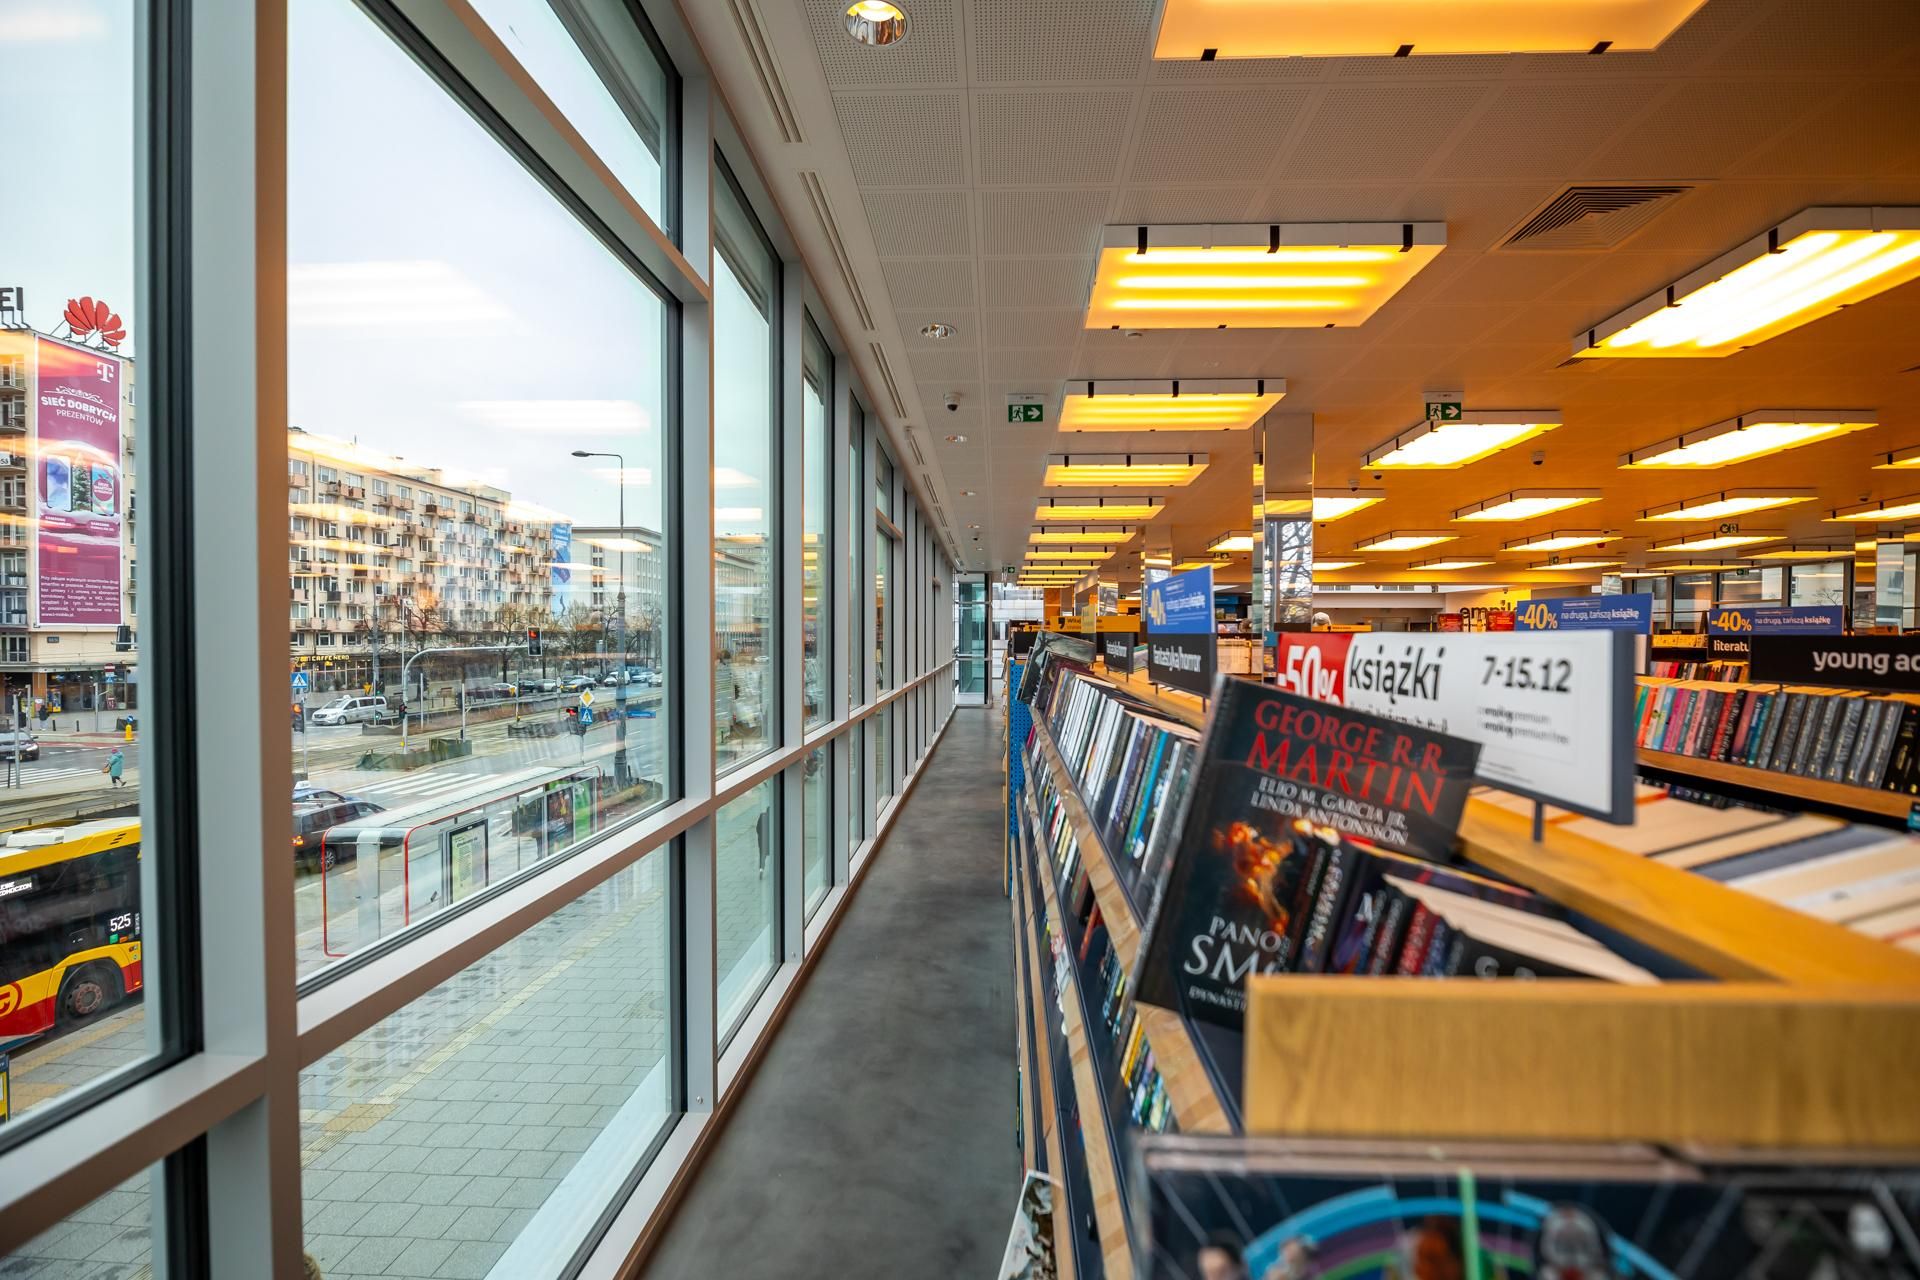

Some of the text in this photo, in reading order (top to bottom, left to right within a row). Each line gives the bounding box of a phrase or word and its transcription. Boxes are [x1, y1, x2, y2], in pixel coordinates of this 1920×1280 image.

[0, 286, 24, 311] EI
[96, 361, 115, 383] T
[41, 395, 117, 422] SIEĆ DOBRYCH
[56, 408, 104, 426] PREZENTÓW
[1518, 603, 1558, 630] -40%
[1711, 611, 1752, 631] -40%
[1782, 616, 1804, 626] tańszą
[1804, 615, 1832, 625] książkę
[1349, 644, 1447, 704] książki
[1812, 651, 1891, 675] young
[1254, 699, 1384, 756] GEORGE
[1246, 731, 1446, 816] MARTIN
[1258, 776, 1298, 800] ELIO
[1321, 793, 1384, 823] GARCIA
[1250, 791, 1409, 846] LINDA ANTONSSON
[110, 912, 131, 932] 525
